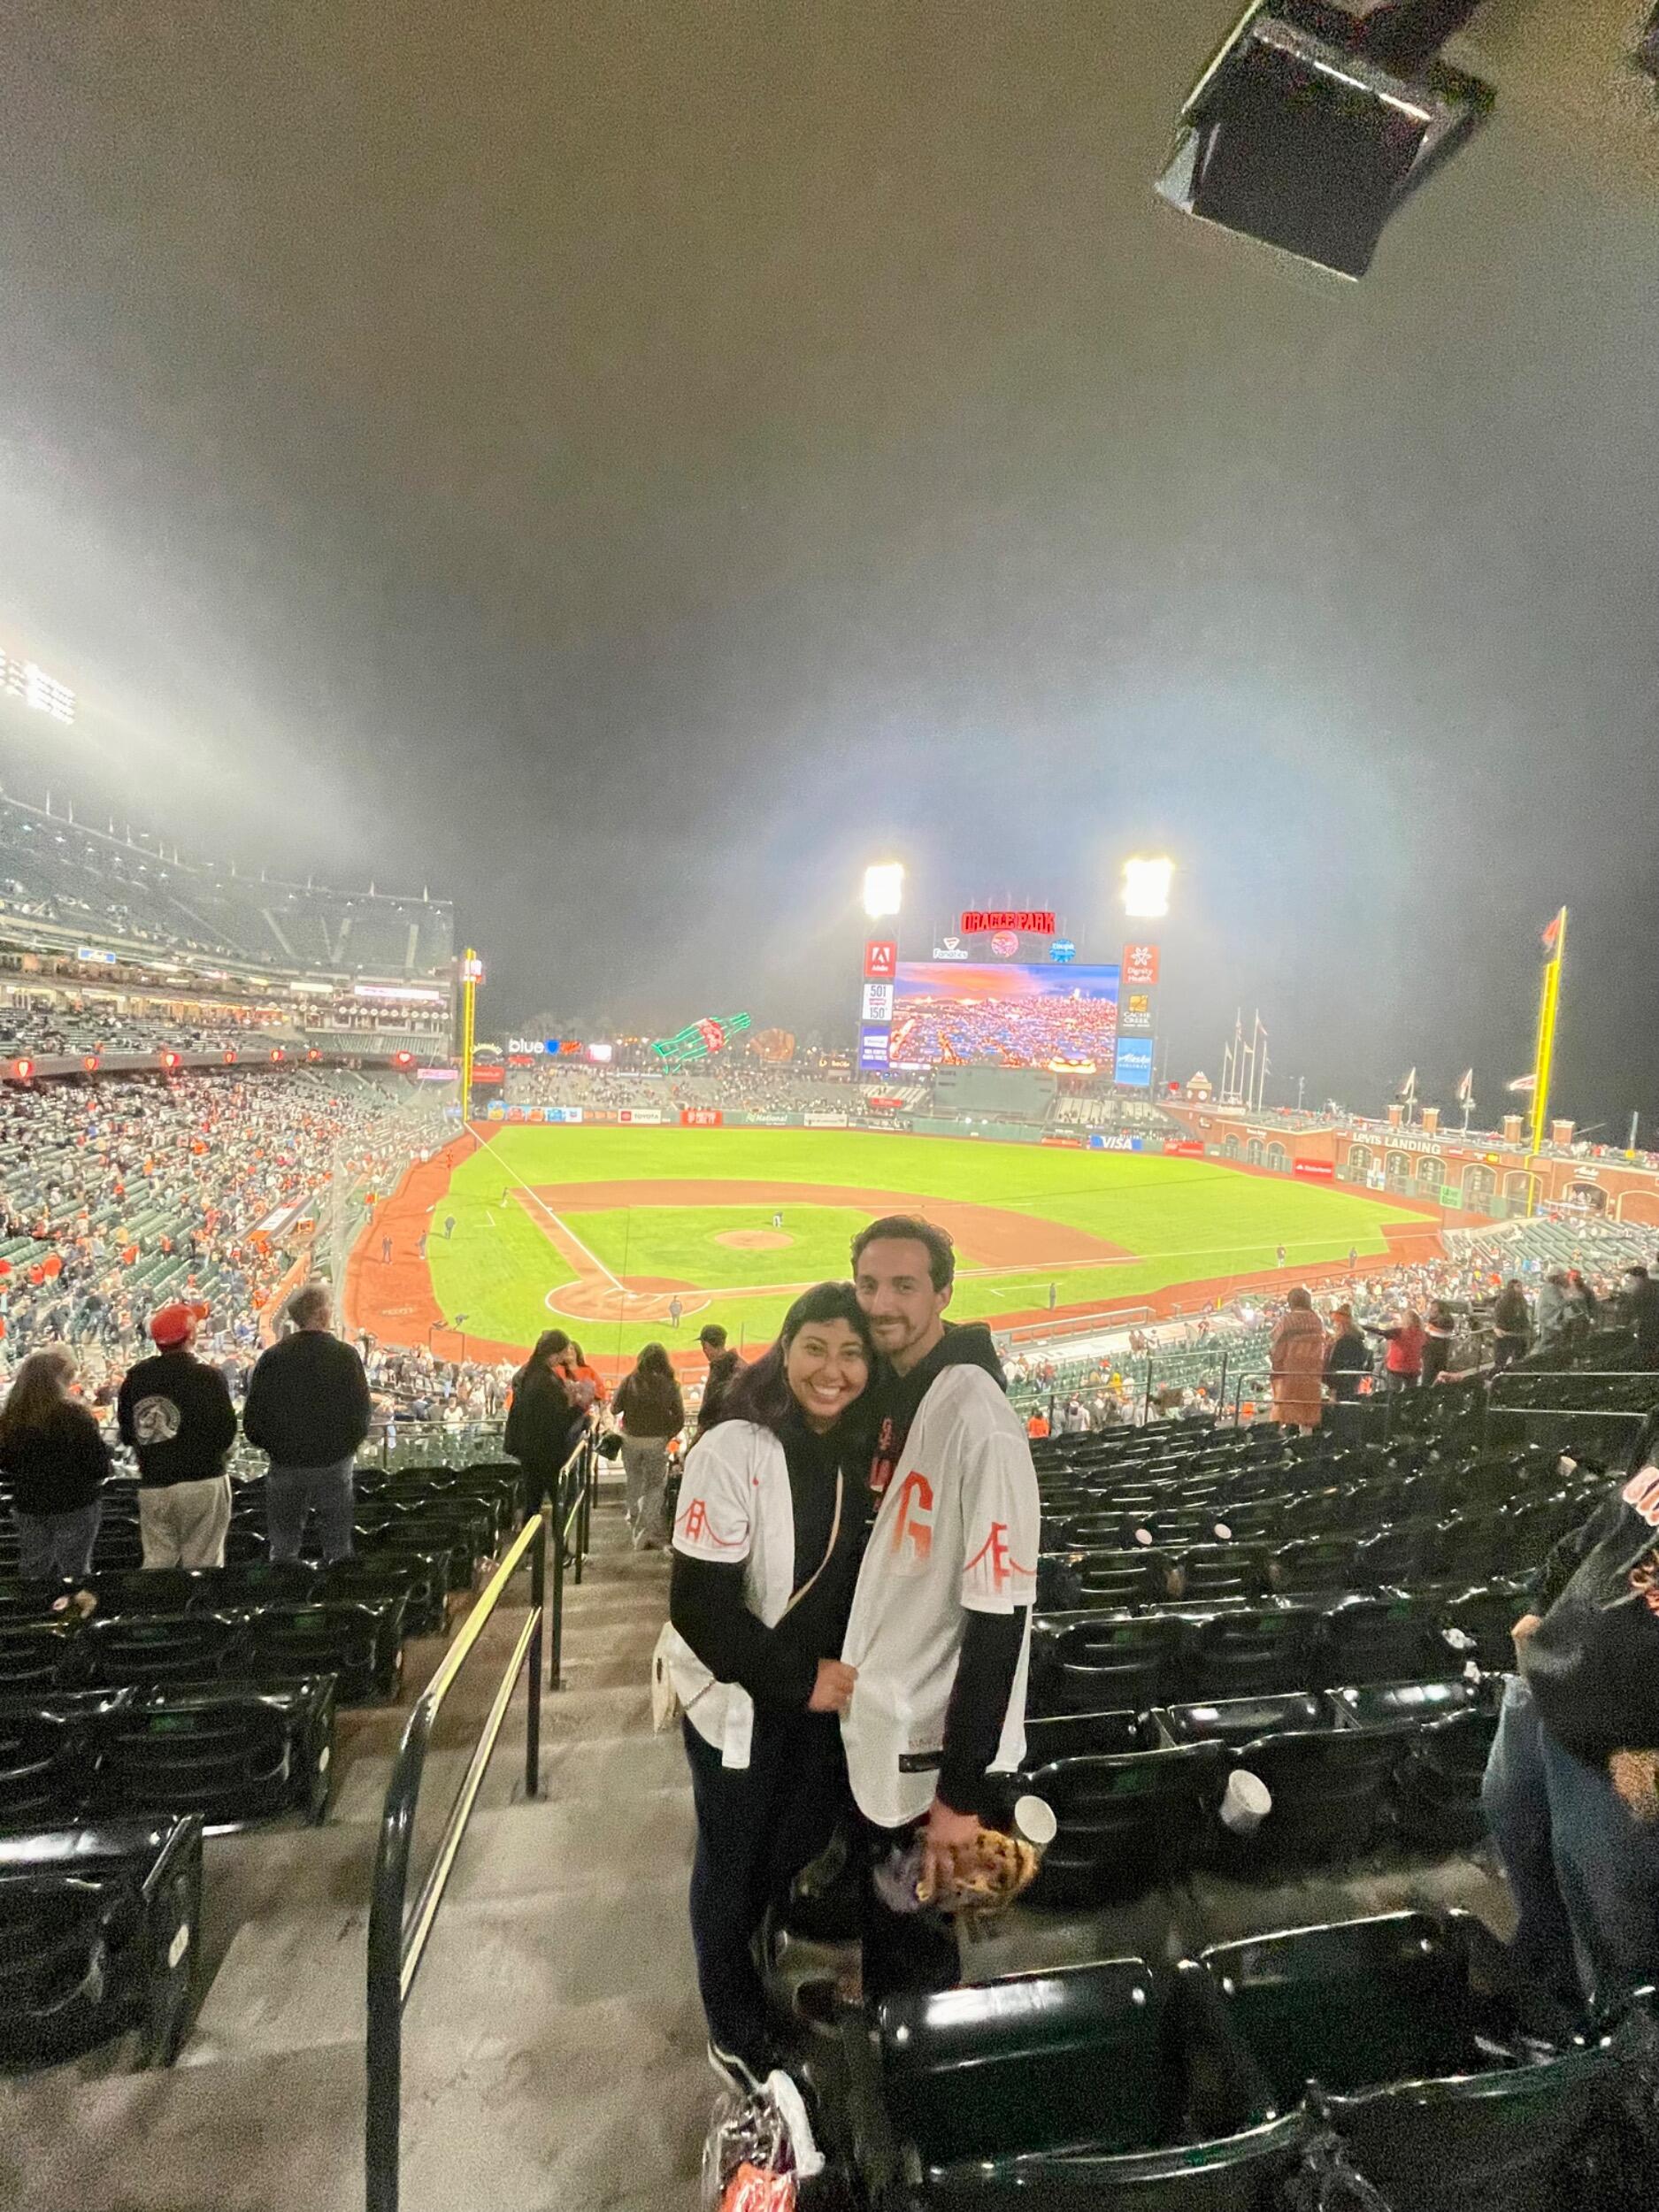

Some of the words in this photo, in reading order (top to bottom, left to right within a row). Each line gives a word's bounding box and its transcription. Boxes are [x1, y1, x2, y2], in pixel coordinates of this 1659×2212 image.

[962, 912, 1016, 933] ORACLE
[1018, 913, 1056, 935] PARK
[933, 948, 968, 959] Fanatics
[1127, 967, 1153, 977] Dignity
[870, 985, 886, 997] 501
[509, 1038, 545, 1054] blue
[1101, 1135, 1133, 1150] VISA
[1385, 1136, 1441, 1155] LANDING
